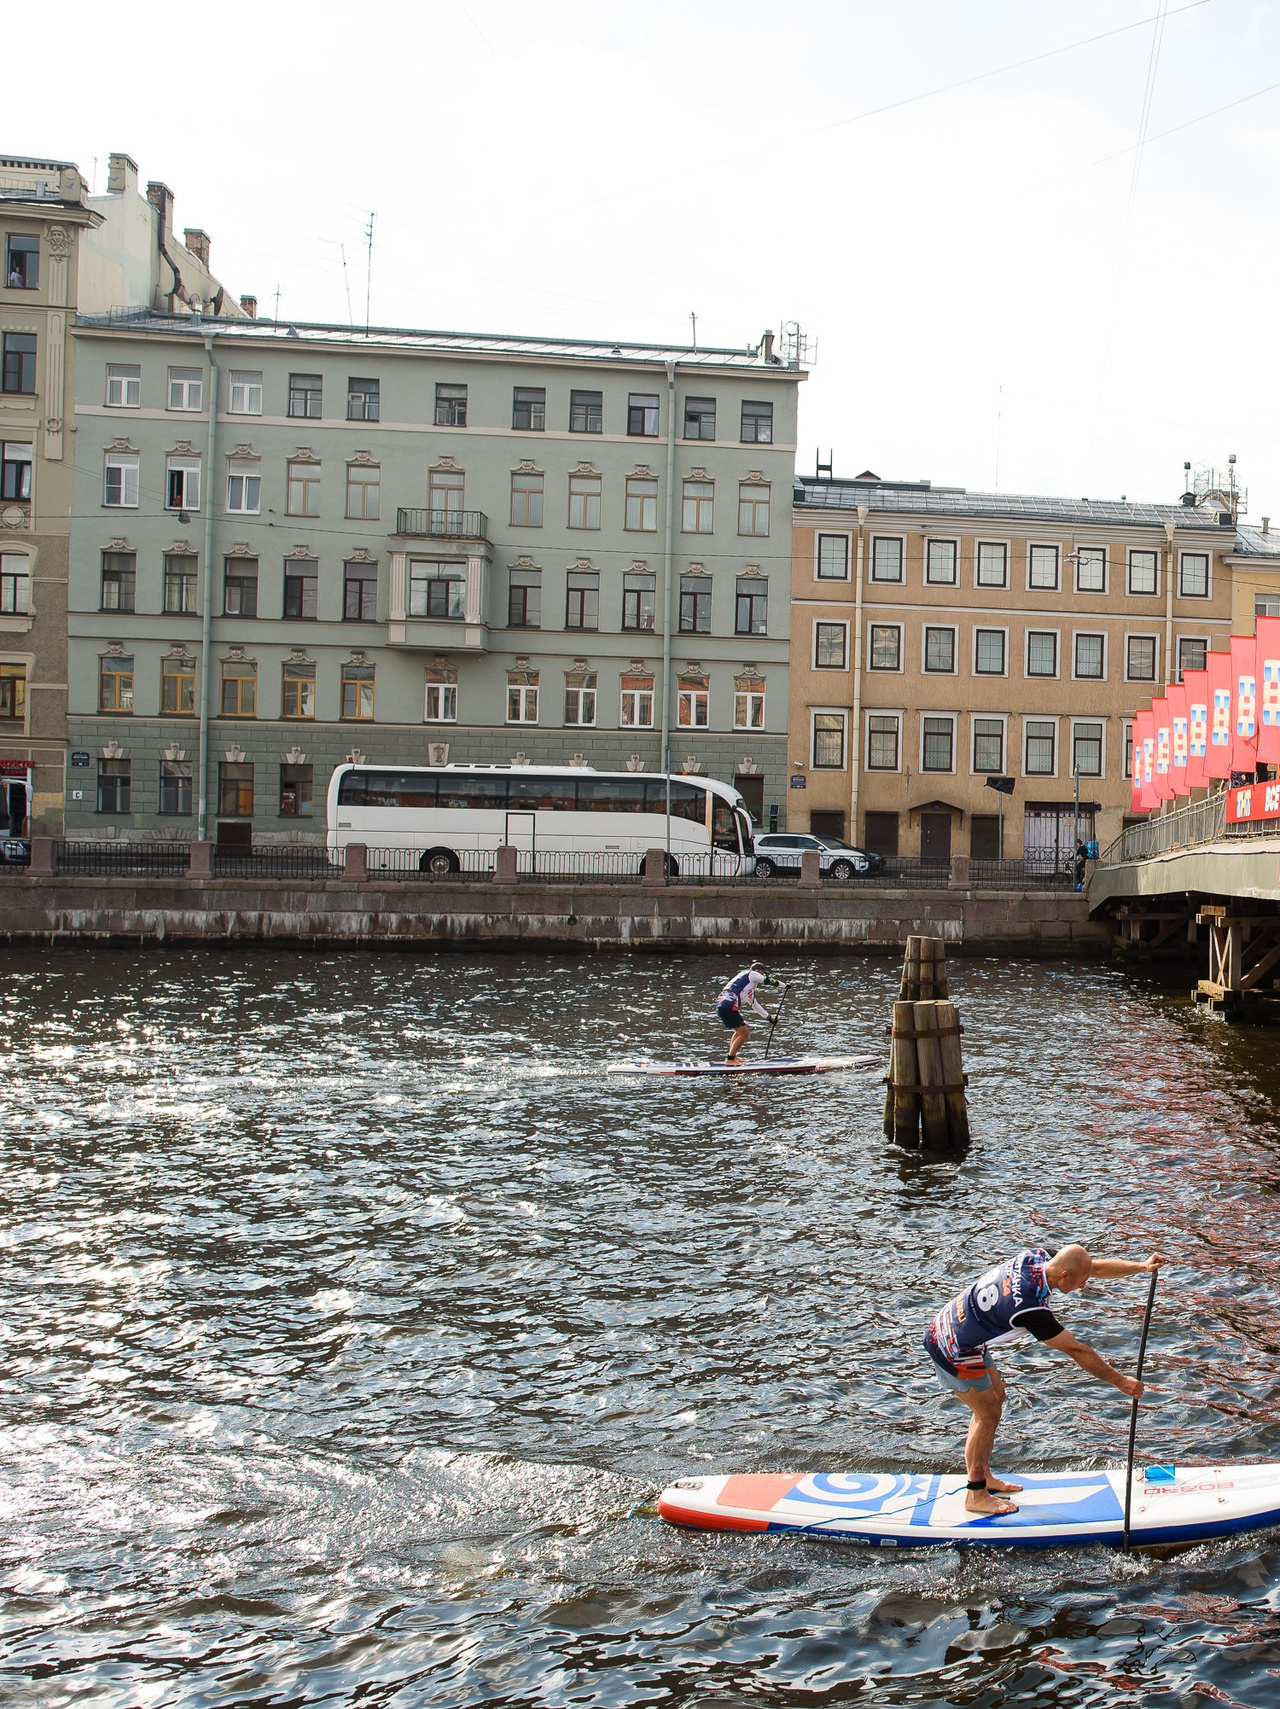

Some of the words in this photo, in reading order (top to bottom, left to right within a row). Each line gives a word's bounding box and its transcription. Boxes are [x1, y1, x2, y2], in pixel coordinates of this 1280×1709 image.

[1190, 703, 1207, 757] ТНТ
[1212, 690, 1231, 746] ТНТ
[1237, 676, 1255, 737] ТНТ
[1158, 728, 1170, 774] ТНТ
[1173, 717, 1188, 767] ТНТ
[1236, 789, 1252, 819] ТНТ
[1265, 784, 1280, 812] ВСЕ
[955, 1295, 967, 1324] ИКСИ
